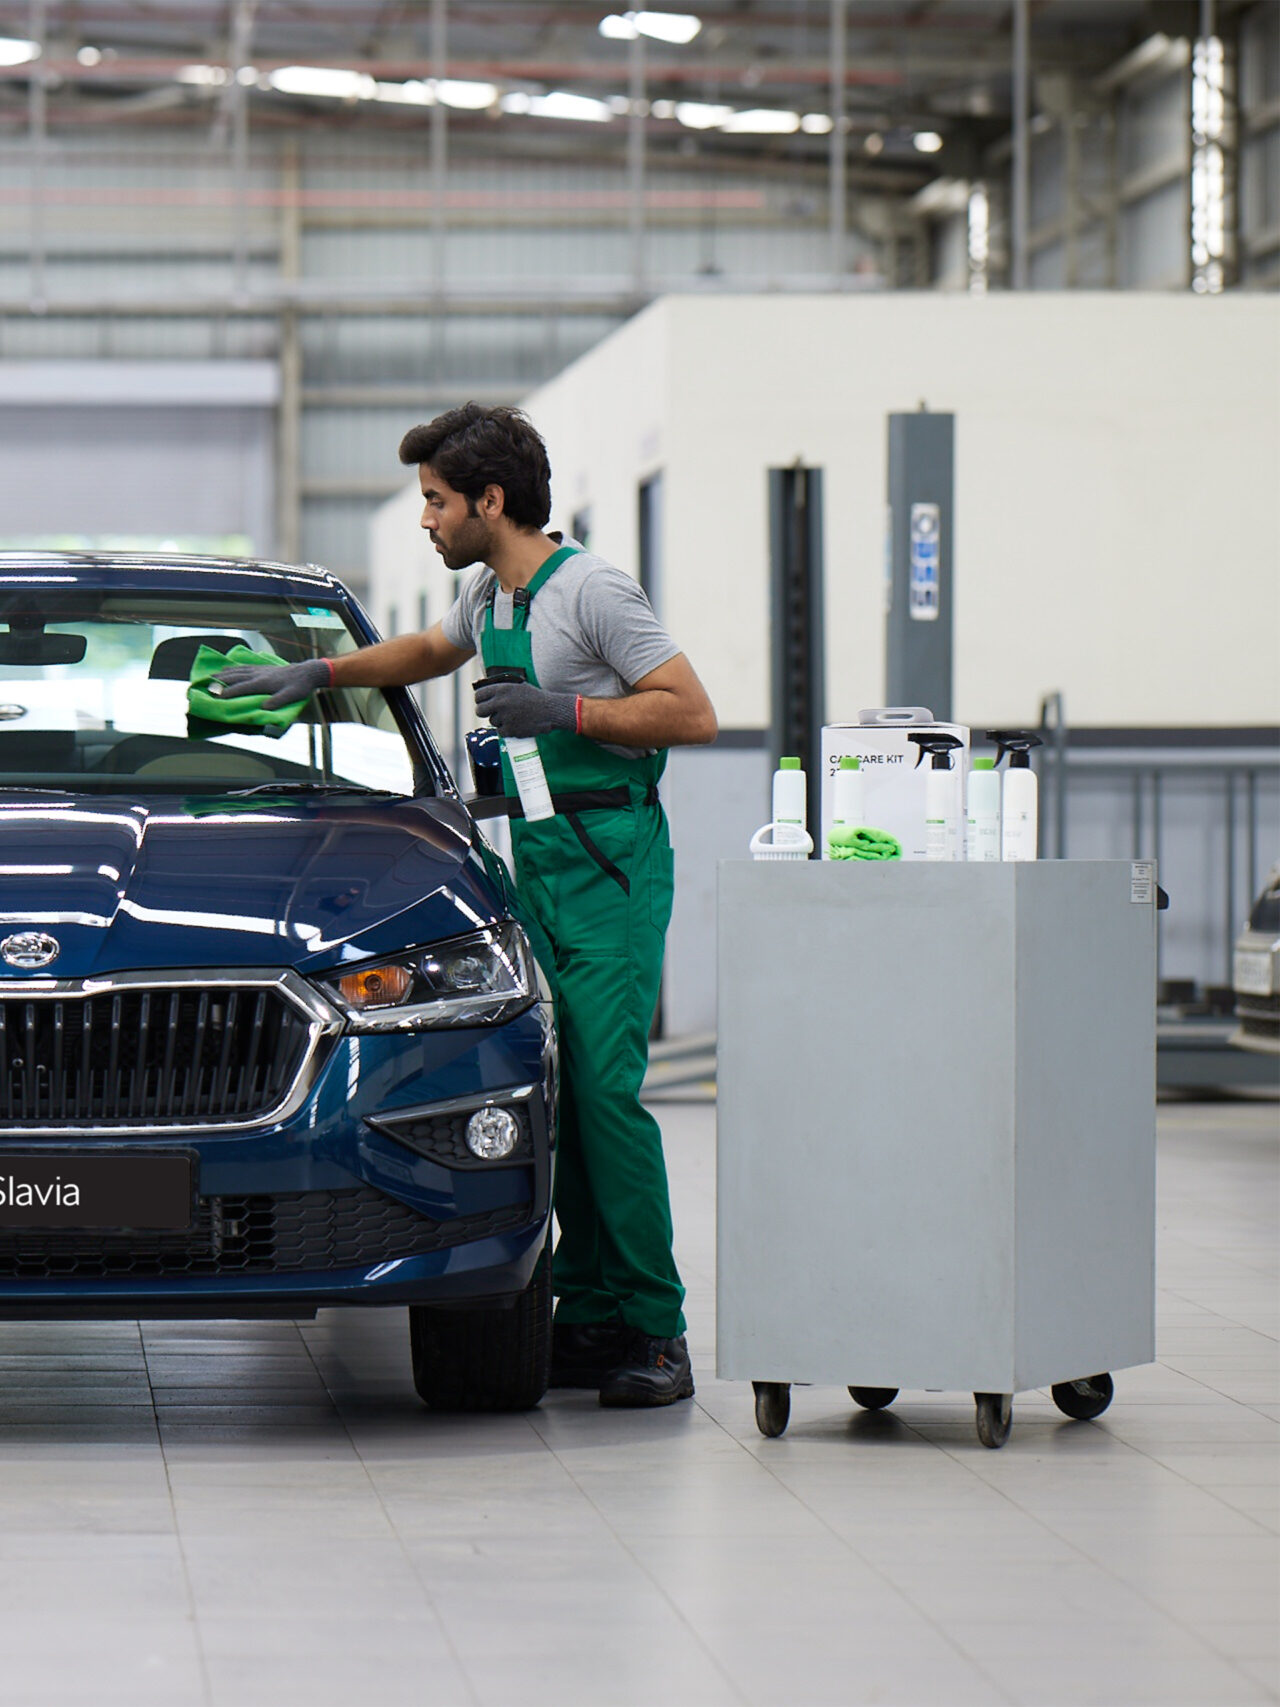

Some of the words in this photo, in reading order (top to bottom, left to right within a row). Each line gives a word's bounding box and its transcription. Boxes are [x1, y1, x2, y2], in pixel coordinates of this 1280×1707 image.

[829, 755, 852, 764] CA
[856, 755, 884, 764] CARE
[886, 754, 904, 764] KIT
